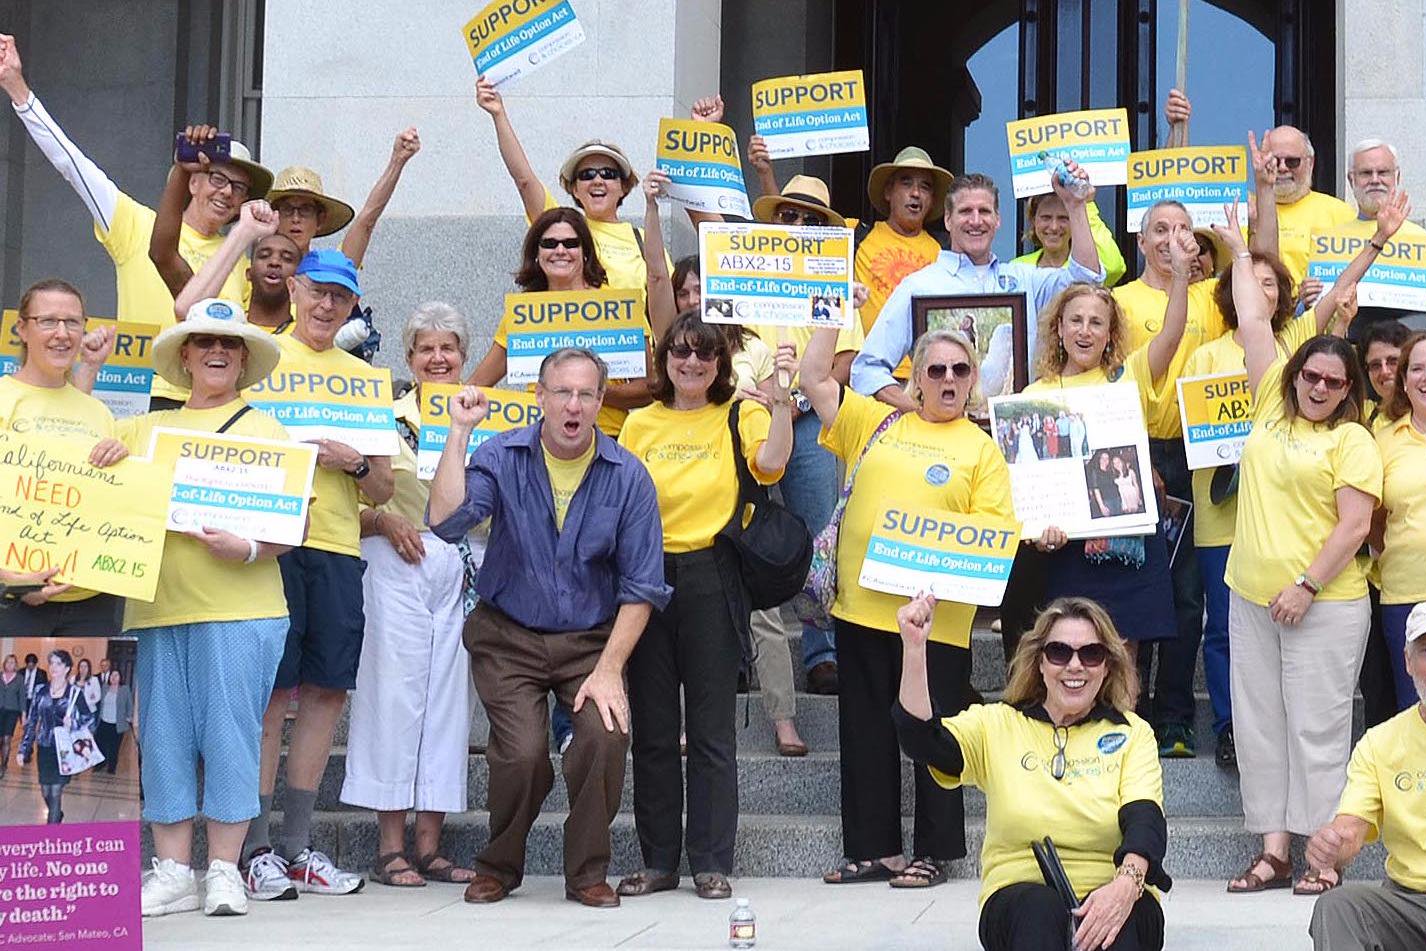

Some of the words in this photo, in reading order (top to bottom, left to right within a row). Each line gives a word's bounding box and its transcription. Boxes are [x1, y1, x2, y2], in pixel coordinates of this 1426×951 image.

[501, 35, 521, 52] Life
[520, 16, 552, 40] Option
[550, 7, 569, 23] Act
[755, 81, 858, 109] SUPPORT
[772, 119, 783, 129] of
[785, 115, 805, 128] Life
[806, 113, 841, 129] Option
[843, 111, 861, 122] Act
[1015, 118, 1121, 147] SUPPORT
[1016, 157, 1031, 168] End
[1070, 149, 1107, 161] Option
[1107, 147, 1125, 156] Act
[1133, 155, 1240, 180] SUPPORT
[661, 164, 684, 176] End
[686, 166, 699, 177] of
[701, 168, 720, 180] Life
[1132, 188, 1150, 202] End
[1151, 187, 1163, 200] of
[1164, 187, 1185, 199] Life
[1187, 187, 1222, 201] Option
[1224, 186, 1241, 198] Act
[730, 235, 825, 254] SUPPORT
[720, 256, 792, 272] ABX2-15
[1313, 266, 1332, 279] End
[1371, 269, 1407, 283] Option
[1408, 270, 1426, 283] Act
[710, 278, 780, 293] End-of-Life
[782, 282, 822, 297] Option
[513, 299, 636, 325] SUPPORT
[512, 338, 535, 350] End
[536, 337, 549, 349] of
[551, 334, 575, 349] Life
[576, 333, 615, 348] Option
[617, 333, 638, 345] Act
[123, 373, 146, 385] Act
[277, 407, 292, 418] of
[294, 407, 321, 419] Life
[322, 408, 364, 424] Option
[366, 411, 388, 424] Act
[0, 444, 124, 486] alifornians
[180, 442, 285, 468] SUPPORT
[15, 475, 82, 508] NEED
[228, 493, 273, 508] Option
[275, 499, 299, 512] Act
[0, 504, 23, 520] nd
[29, 510, 44, 527] of
[51, 512, 91, 537] Life
[97, 521, 153, 544] Option
[882, 509, 1014, 549] SUPPORT
[91, 553, 127, 577] ABX2
[131, 562, 148, 578] 15
[873, 542, 899, 558] End
[900, 547, 914, 561] of
[915, 550, 941, 567] Life
[940, 556, 982, 573] Option
[983, 560, 1005, 574] Act
[0, 837, 83, 859] verything
[85, 837, 93, 853] I
[96, 839, 125, 852] can
[10, 861, 43, 879] life.
[46, 861, 72, 877] No
[74, 862, 108, 876] one
[15, 884, 47, 901] the
[50, 881, 97, 901] right
[99, 882, 119, 896] to
[59, 929, 76, 941] San
[113, 926, 128, 938] CA
